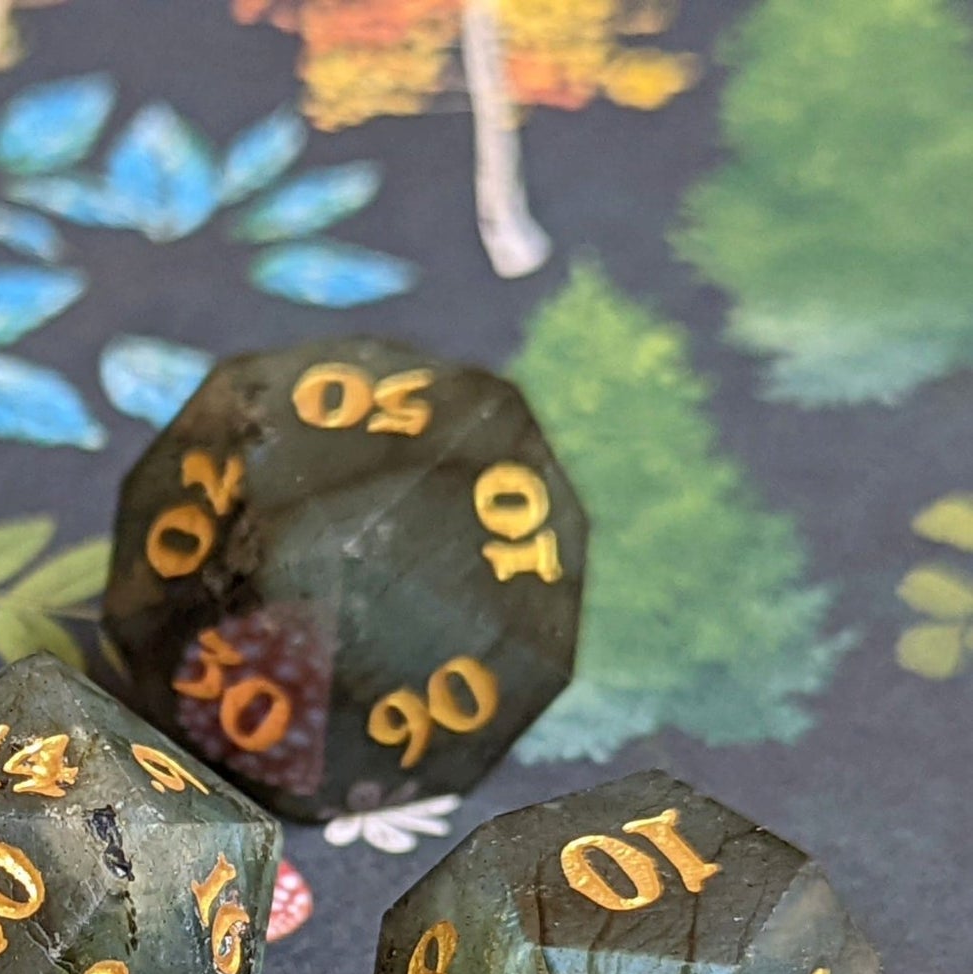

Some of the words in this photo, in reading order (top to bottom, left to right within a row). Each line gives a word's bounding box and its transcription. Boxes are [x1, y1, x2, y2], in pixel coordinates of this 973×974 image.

[292, 361, 433, 437] 50
[473, 461, 563, 584] 10
[172, 629, 292, 751] 30
[367, 655, 497, 769] 90
[560, 807, 723, 912] 10
